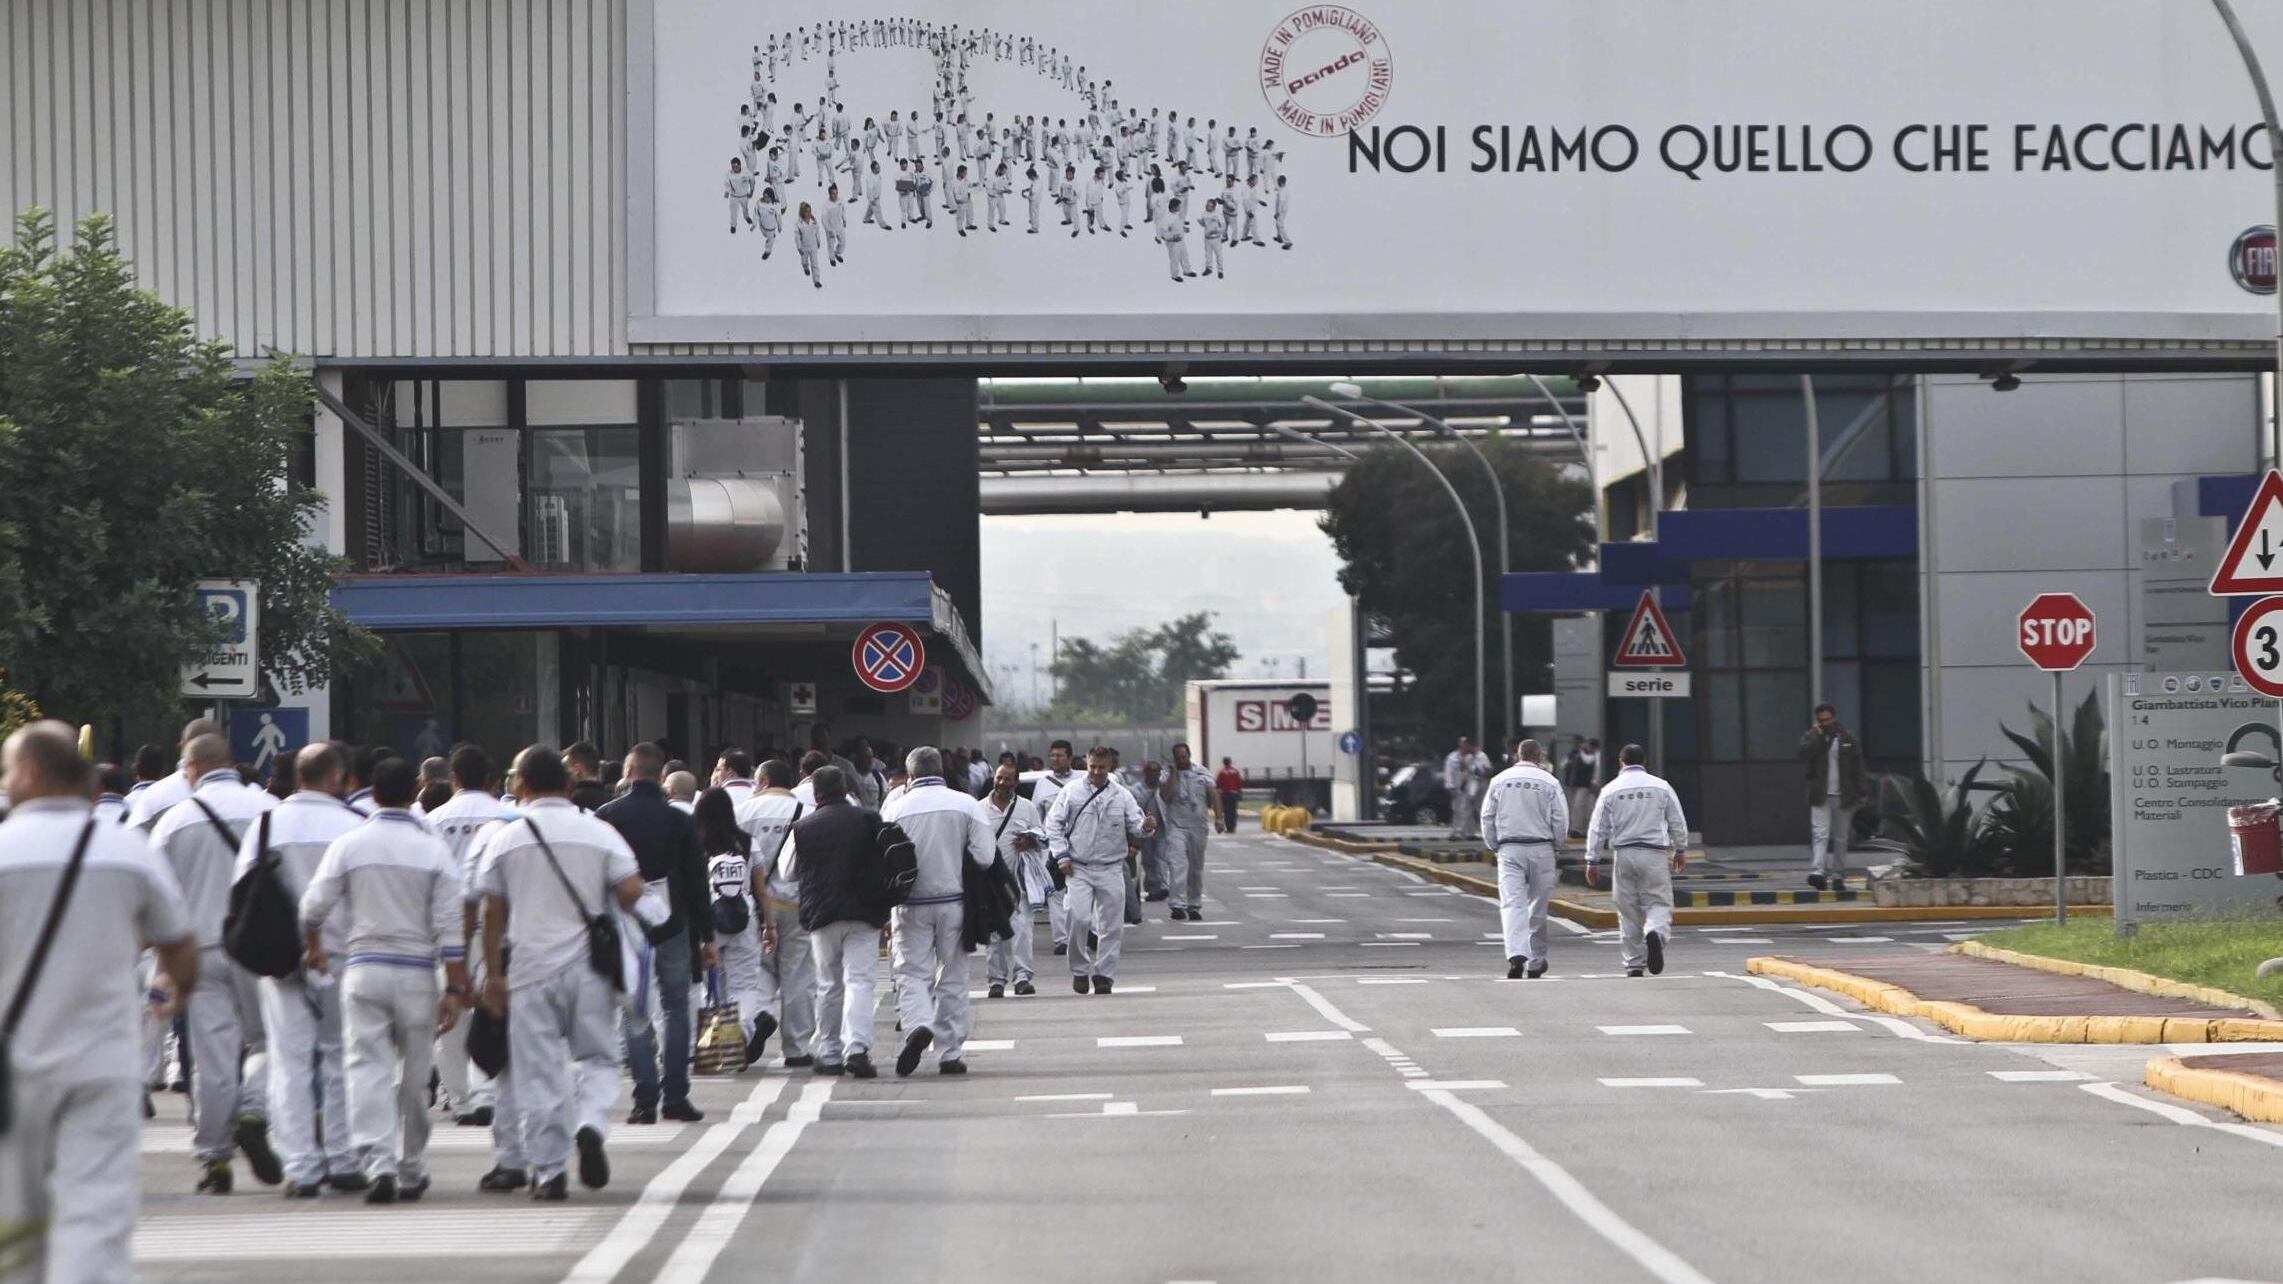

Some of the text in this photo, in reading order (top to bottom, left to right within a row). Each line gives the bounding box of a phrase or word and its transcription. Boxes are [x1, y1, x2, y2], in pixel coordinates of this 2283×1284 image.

[1263, 9, 1377, 88] MADE IN POMIGLIANO
[1288, 50, 1365, 94] panda
[1277, 99, 1315, 132] MADE
[1320, 117, 1334, 134] IN
[1348, 124, 1446, 173] NOI
[1471, 124, 1639, 173] SIAMO
[1660, 123, 1873, 180] QUELLO
[1893, 123, 1990, 172] CHE
[2247, 246, 2277, 276] FIA
[2023, 618, 2092, 646] STOP
[203, 652, 249, 666] IGENTI
[1625, 677, 1674, 692] serie
[2132, 697, 2279, 711] Giambattista Vico Plan
[2167, 739, 2224, 752] Montaggio
[2167, 765, 2223, 775] Lastratura
[2167, 777, 2229, 791] Stampaggio
[2134, 797, 2175, 808] Centro
[2134, 810, 2183, 821] Materiali
[718, 865, 743, 879] FIAT
[2135, 869, 2179, 881] Plastica
[2191, 868, 2224, 880] CDC
